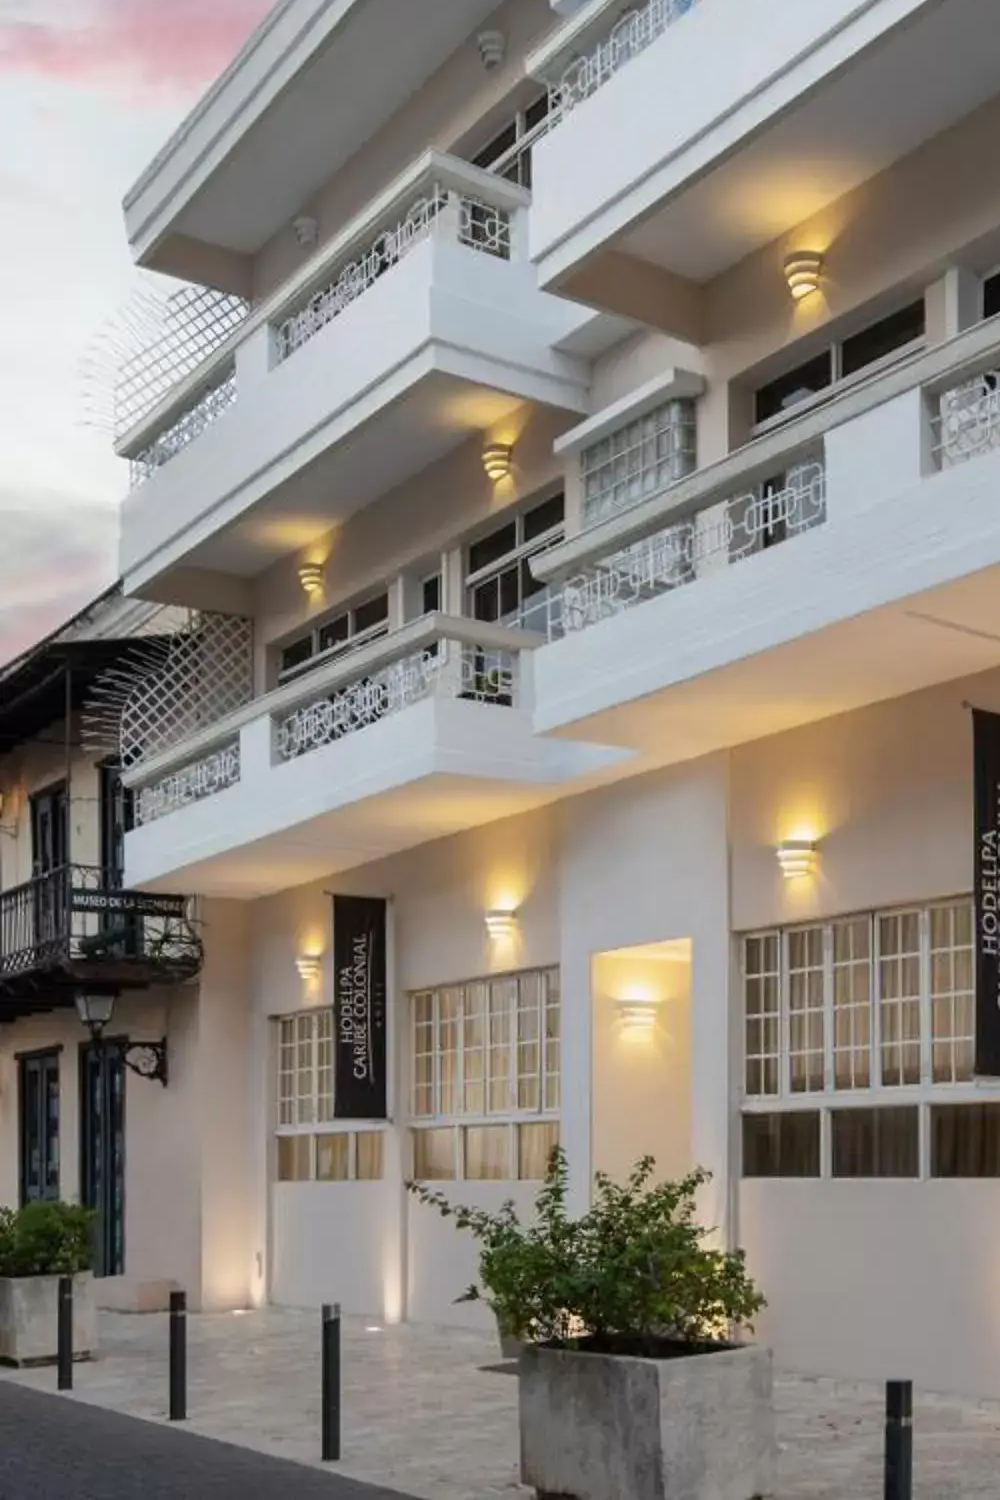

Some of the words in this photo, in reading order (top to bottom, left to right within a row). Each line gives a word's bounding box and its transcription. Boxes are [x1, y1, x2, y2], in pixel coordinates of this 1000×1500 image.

[981, 830, 998, 955] HODELPA
[340, 965, 353, 1044] HODELPA
[353, 933, 367, 1017] COLONIAL
[353, 1022, 367, 1079] CARIBE
